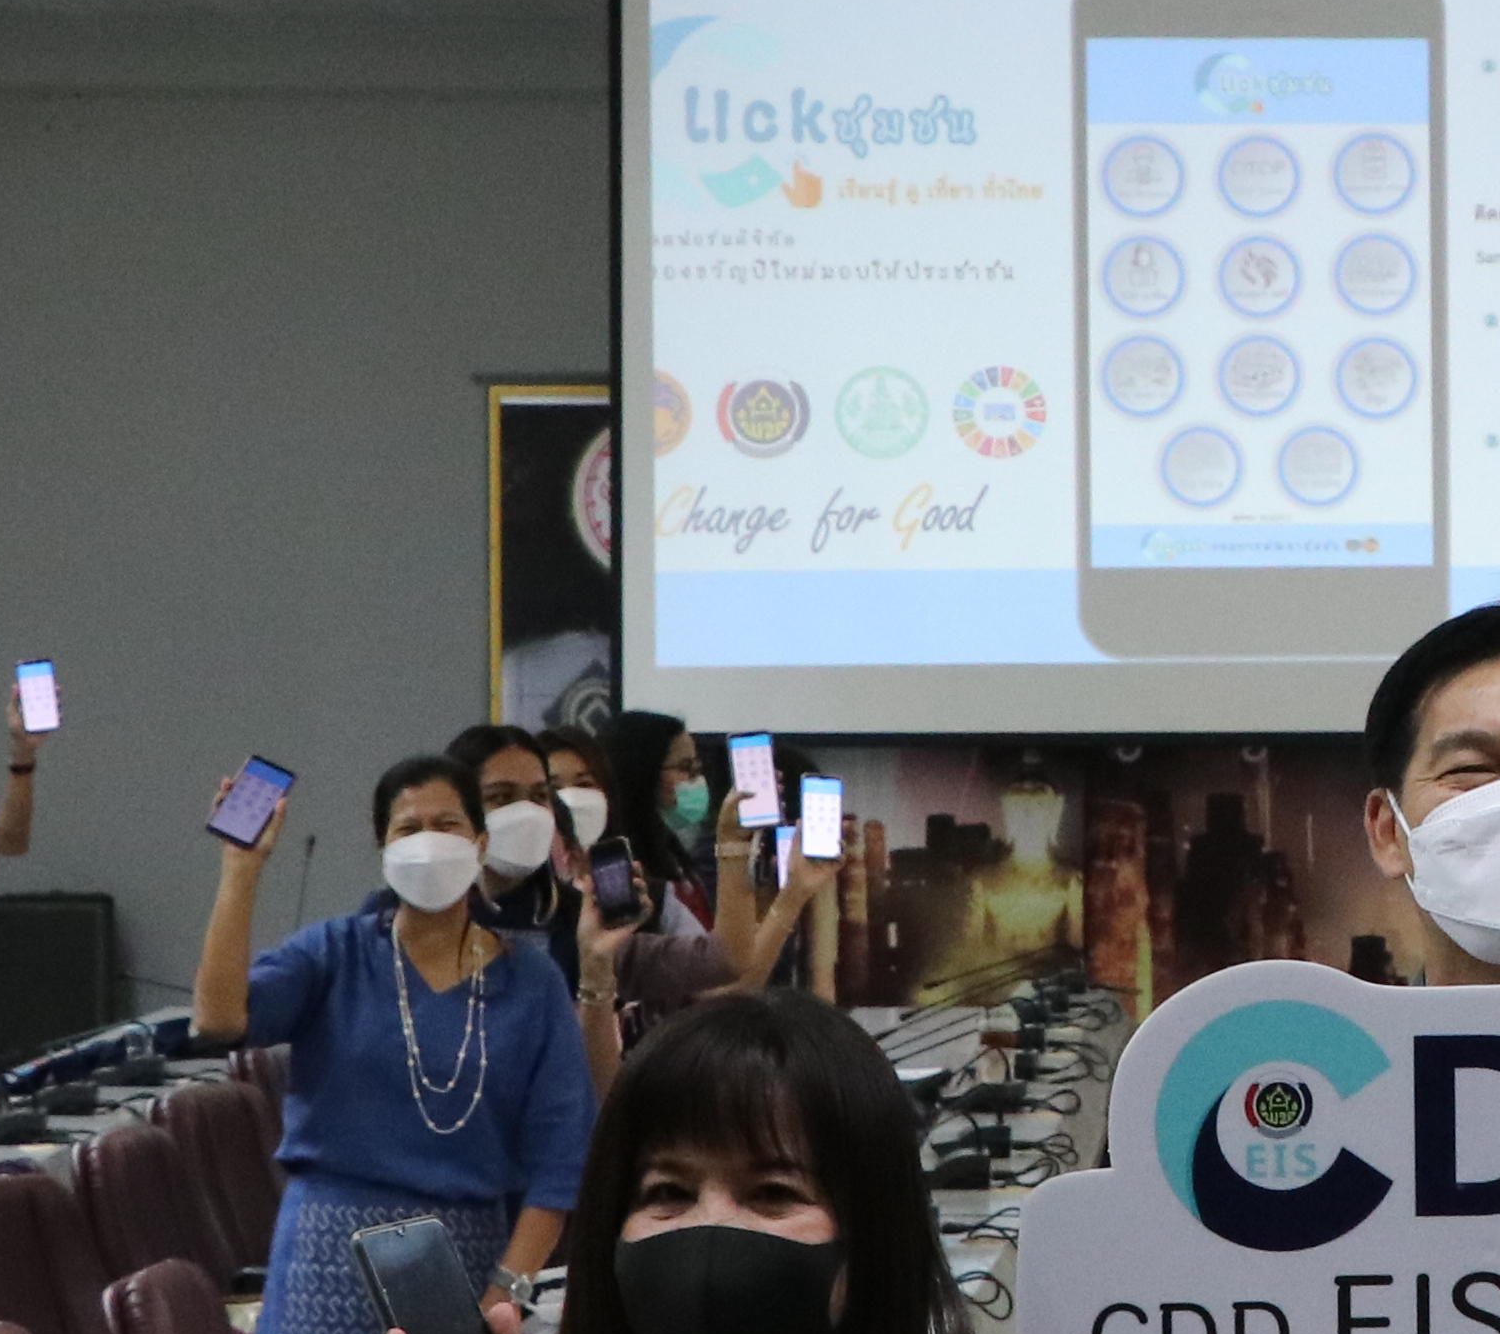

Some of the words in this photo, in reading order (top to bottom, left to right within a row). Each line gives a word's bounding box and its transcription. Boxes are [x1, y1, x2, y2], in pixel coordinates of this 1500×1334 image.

[655, 485, 791, 554] Change
[810, 485, 881, 554] for
[892, 482, 990, 552] Good
[1245, 1142, 1318, 1179] EIS
